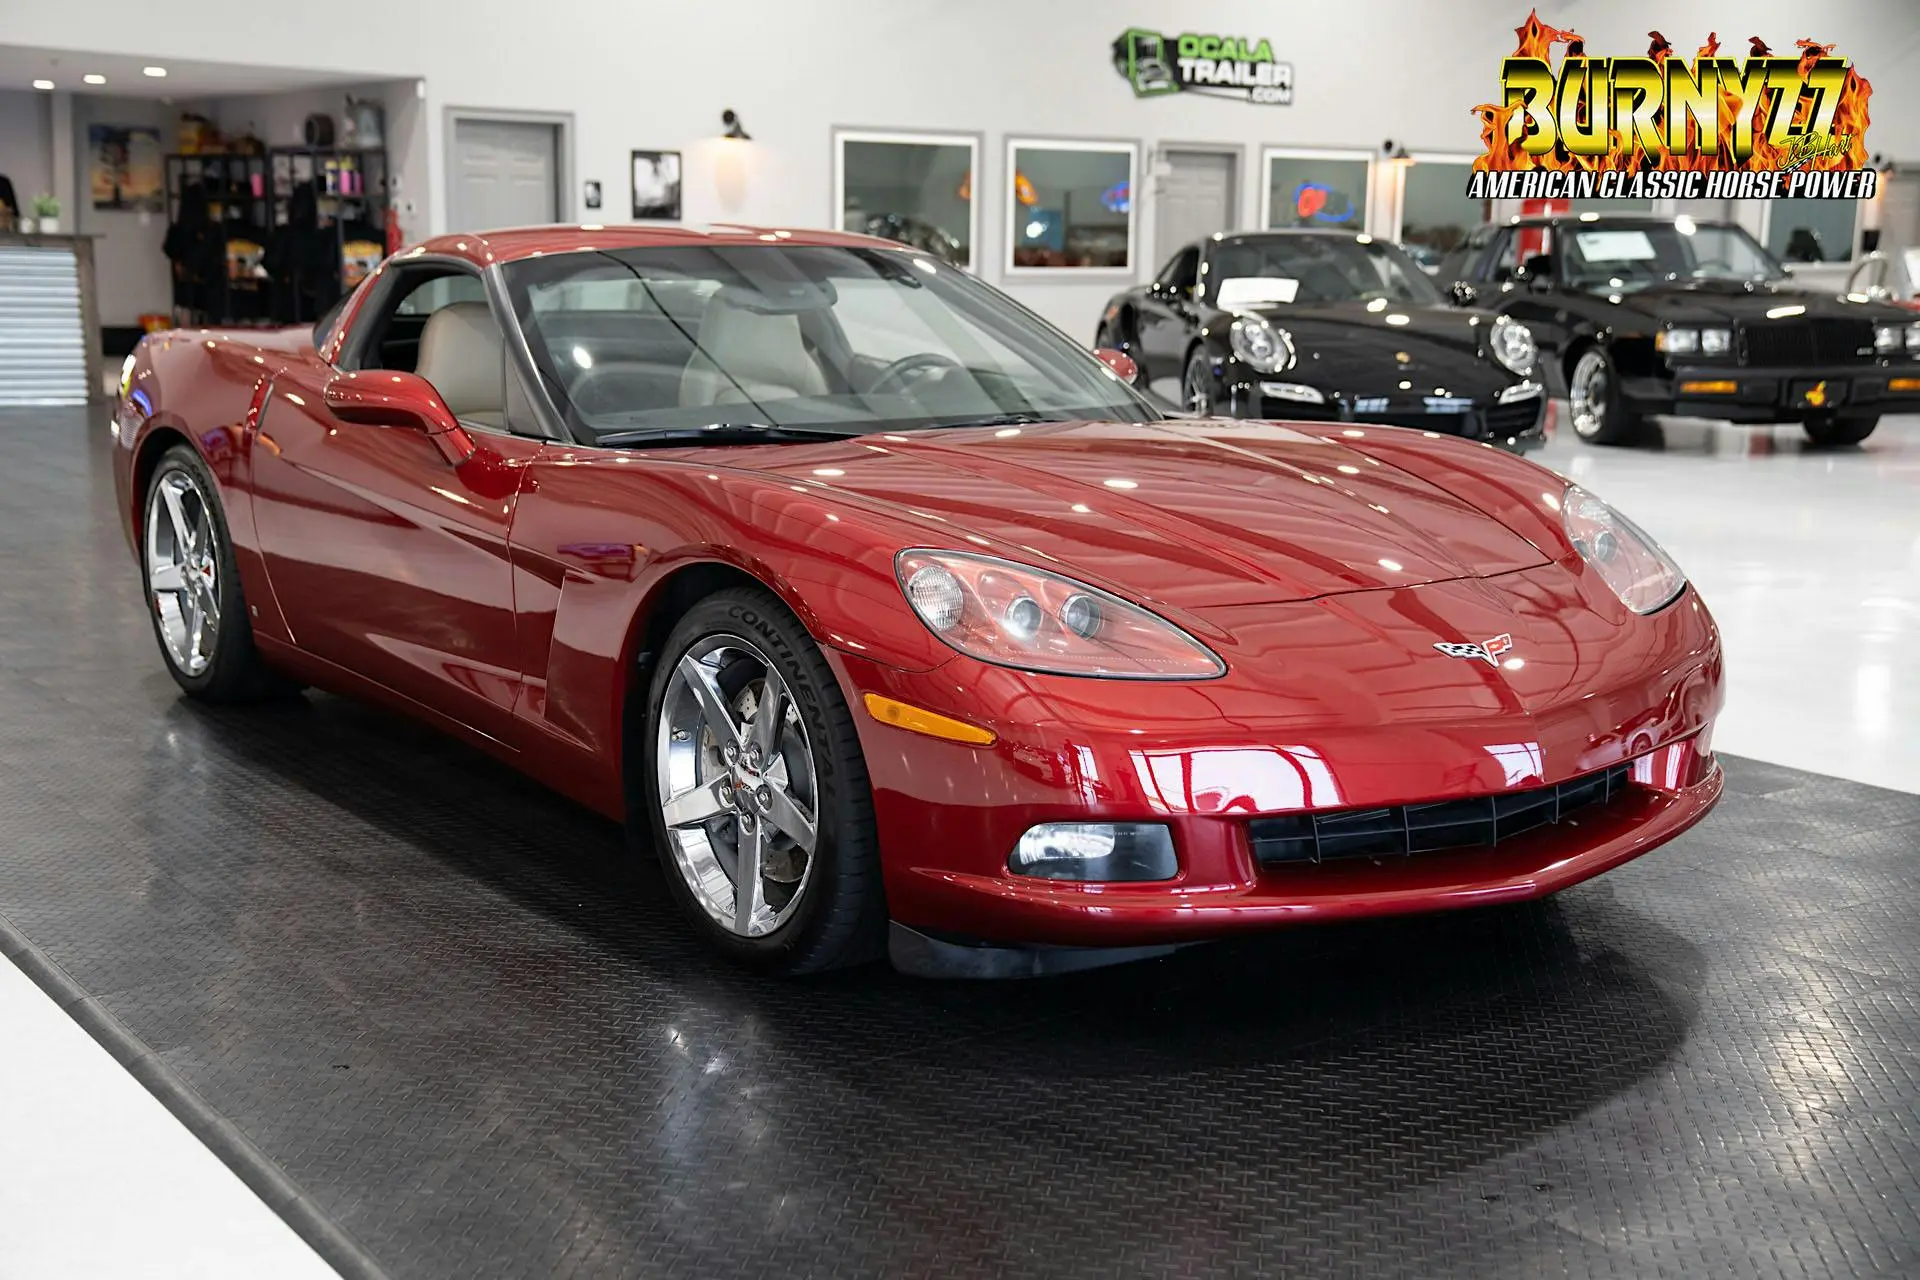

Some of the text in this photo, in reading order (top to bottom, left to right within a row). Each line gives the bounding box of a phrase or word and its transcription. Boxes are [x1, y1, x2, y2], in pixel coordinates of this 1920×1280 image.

[1177, 33, 1274, 63] OCALA
[1177, 58, 1293, 88] TRAILER
[727, 605, 836, 799] CONTINENTAL
